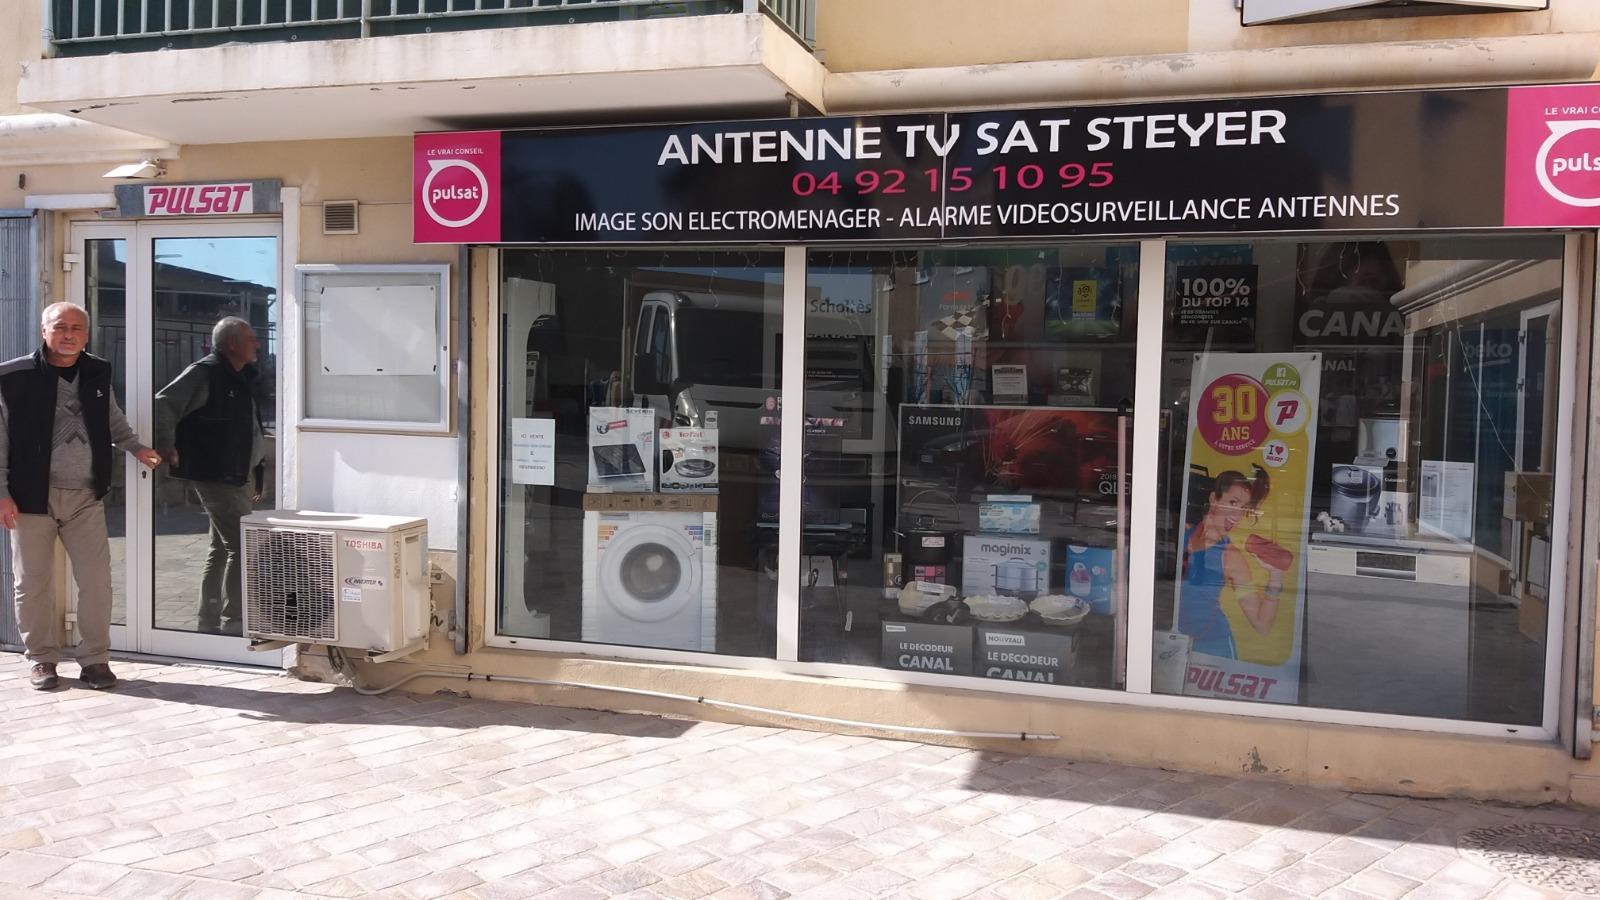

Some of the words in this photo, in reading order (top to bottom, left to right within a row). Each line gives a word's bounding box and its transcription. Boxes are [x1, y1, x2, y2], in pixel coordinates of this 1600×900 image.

[1545, 107, 1559, 115] LE
[1562, 106, 1588, 115] VRAI
[1591, 105, 1600, 114] C
[657, 126, 882, 166] ANTENNE
[896, 123, 961, 158] TV
[976, 118, 1070, 156] SAT
[1086, 109, 1287, 152] STEYER
[454, 147, 484, 155] CONSEIL
[791, 171, 843, 197] 04
[854, 168, 907, 194] 92
[924, 167, 972, 193] 15
[992, 164, 1044, 190] 10
[1058, 162, 1114, 188] 95
[432, 185, 478, 204] pulsat
[574, 211, 636, 232] IMAGE
[641, 210, 683, 232] SON
[688, 207, 881, 232] ELECTROMENAGER
[899, 204, 992, 228] ALARME
[996, 198, 1251, 225] VIDEOSURVEILLANCE
[1258, 193, 1400, 219] ANTENNES
[1182, 278, 1250, 297] 100%
[810, 296, 872, 314] Scholtès
[1182, 298, 1201, 307] DU
[1205, 297, 1231, 307] TOP
[1236, 297, 1249, 307] 14
[1212, 384, 1257, 424] 30
[908, 415, 962, 426] SAMSUNG
[1221, 426, 1250, 442] ANS
[344, 540, 383, 550] TOSHIBA
[980, 543, 1032, 557] magimix
[899, 642, 908, 650] LE
[909, 643, 954, 653] DECODEUR
[898, 654, 954, 671] CANAL
[987, 651, 998, 661] LE
[1001, 653, 1058, 667] DECODEUR
